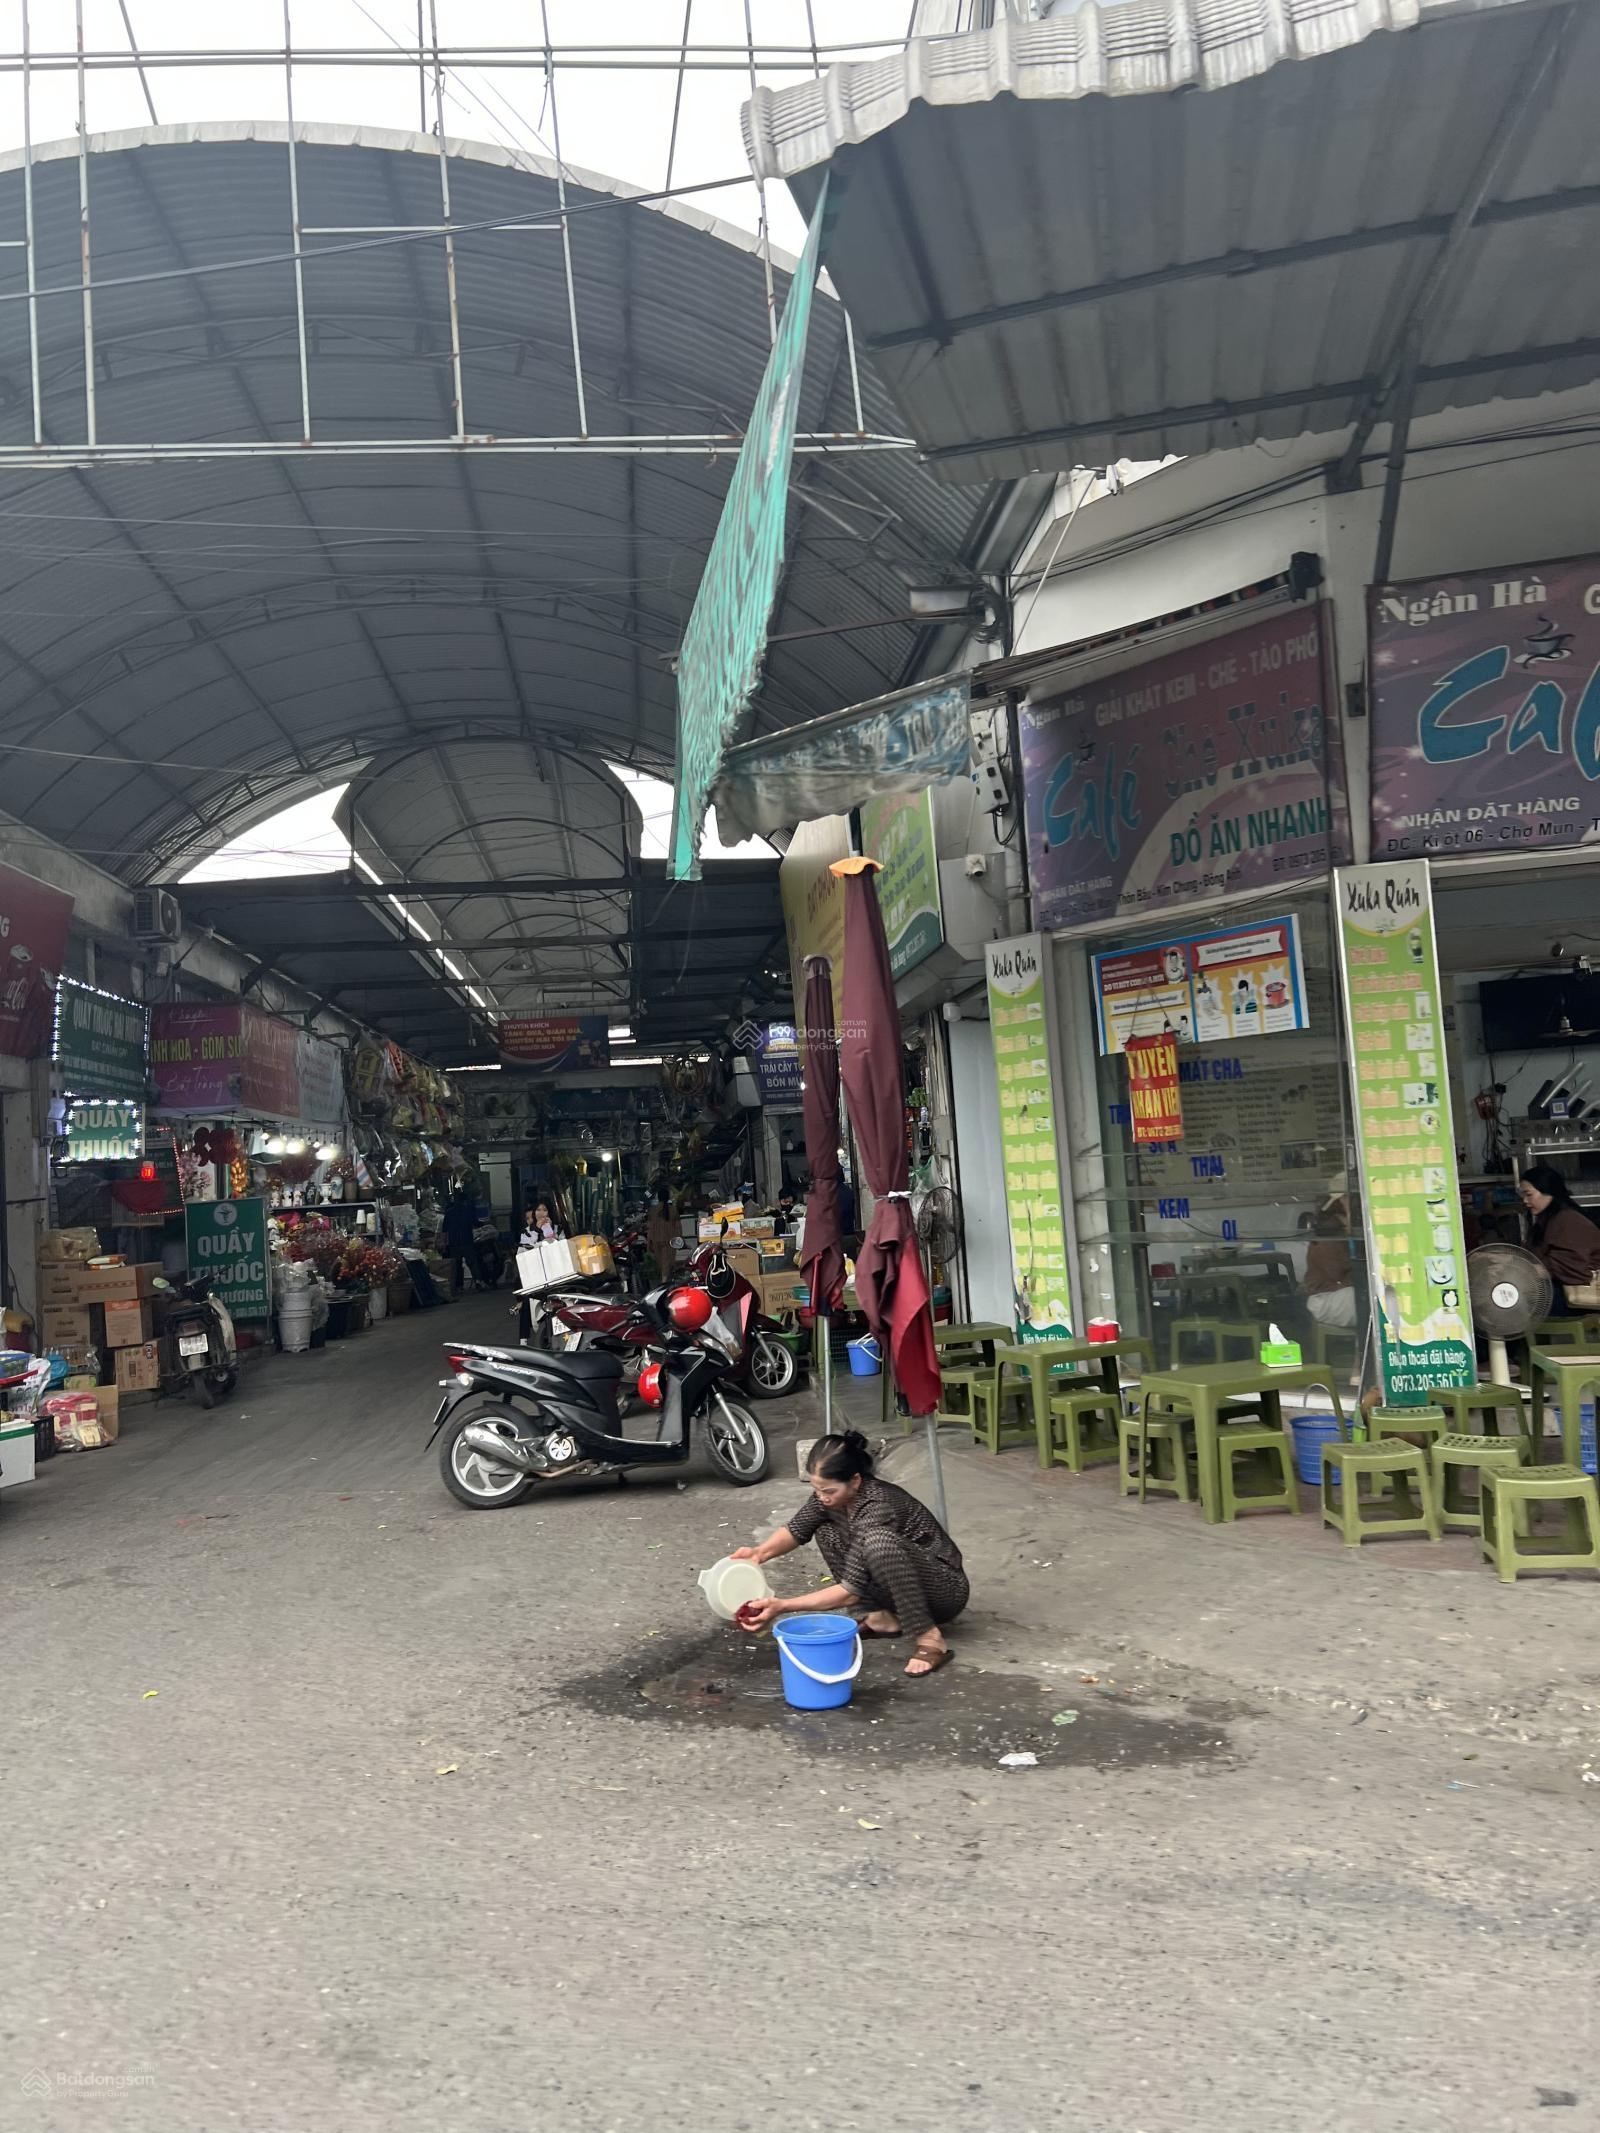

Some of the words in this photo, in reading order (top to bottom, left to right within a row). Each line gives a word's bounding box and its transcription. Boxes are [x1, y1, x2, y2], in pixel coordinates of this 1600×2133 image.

[1376, 590, 1478, 626] Ngân
[1490, 576, 1547, 608] Hà
[1095, 690, 1124, 726] GIẢI
[1126, 681, 1163, 719] KHÁT
[1166, 673, 1197, 704] KEM
[1208, 658, 1238, 690] CHÈ
[1249, 641, 1281, 676] TÀO
[1043, 743, 1143, 862] Café
[1401, 808, 1461, 829] NHẬN
[1467, 802, 1512, 822] ĐẶT
[1518, 797, 1581, 815] HÀNG
[1170, 812, 1200, 868] ĐỒ
[1209, 811, 1242, 860] ĂN
[1246, 797, 1333, 850] NHANH
[1465, 829, 1484, 843] 06
[1539, 822, 1574, 837] Mun
[1385, 878, 1420, 914] Quán
[766, 1074, 786, 1088] BỐN
[778, 1060, 792, 1073] CÂY
[1213, 1057, 1243, 1080] CHA
[1158, 1198, 1190, 1219] KEM
[197, 1227, 255, 1258] QUẦY
[192, 1255, 264, 1285] THUỐC
[1408, 1349, 1428, 1369] thoại
[1430, 1348, 1443, 1369] đặt
